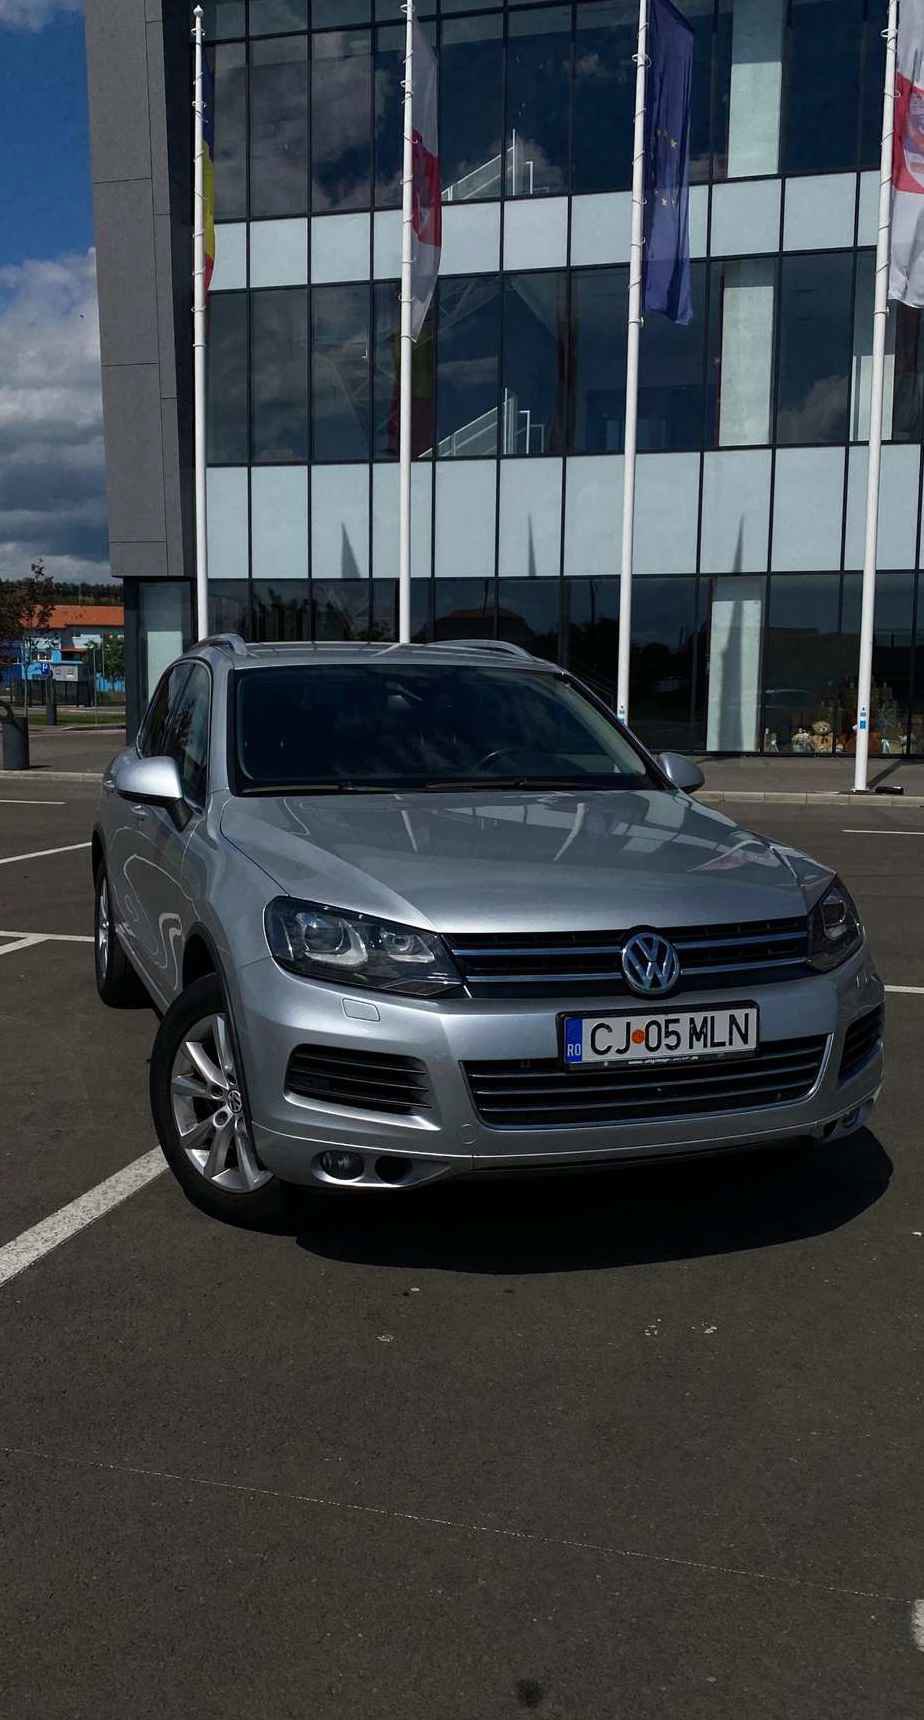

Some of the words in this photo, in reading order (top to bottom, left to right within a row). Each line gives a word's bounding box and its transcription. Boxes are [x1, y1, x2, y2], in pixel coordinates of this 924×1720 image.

[622, 932, 679, 992] VW
[567, 1043, 581, 1057] RO
[590, 1022, 631, 1056] CJ
[644, 1019, 681, 1052] 05
[688, 1012, 750, 1050] MLN
